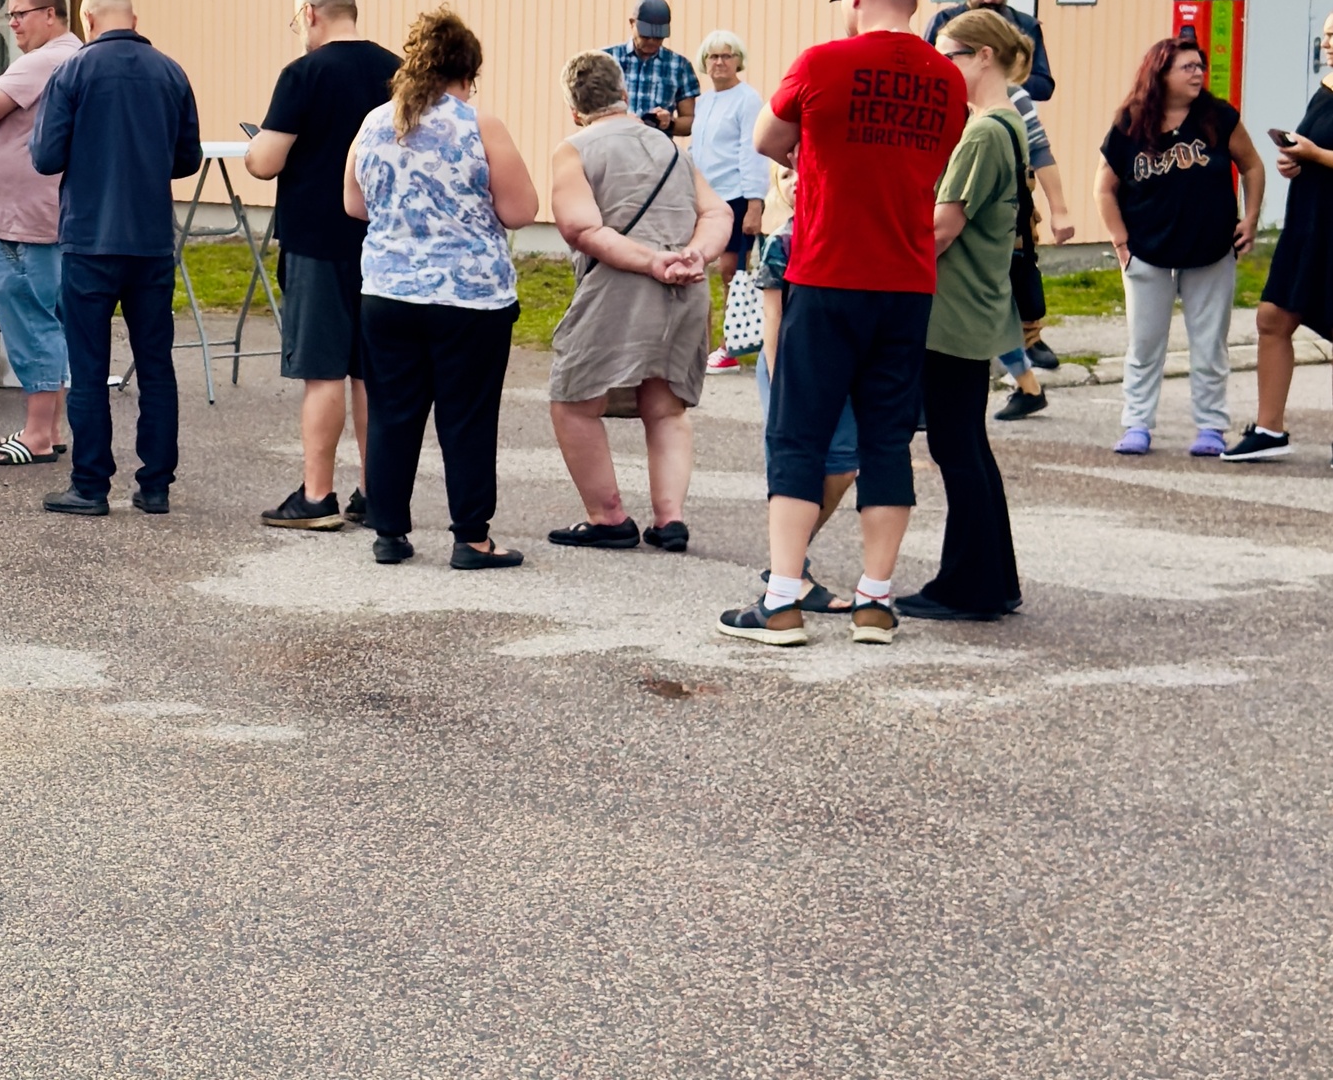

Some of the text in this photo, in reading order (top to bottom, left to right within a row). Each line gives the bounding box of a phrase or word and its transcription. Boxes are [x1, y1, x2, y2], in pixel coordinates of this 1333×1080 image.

[851, 68, 950, 108] SECHS
[847, 99, 947, 133] HERZEN
[861, 126, 941, 153] BRENNEN
